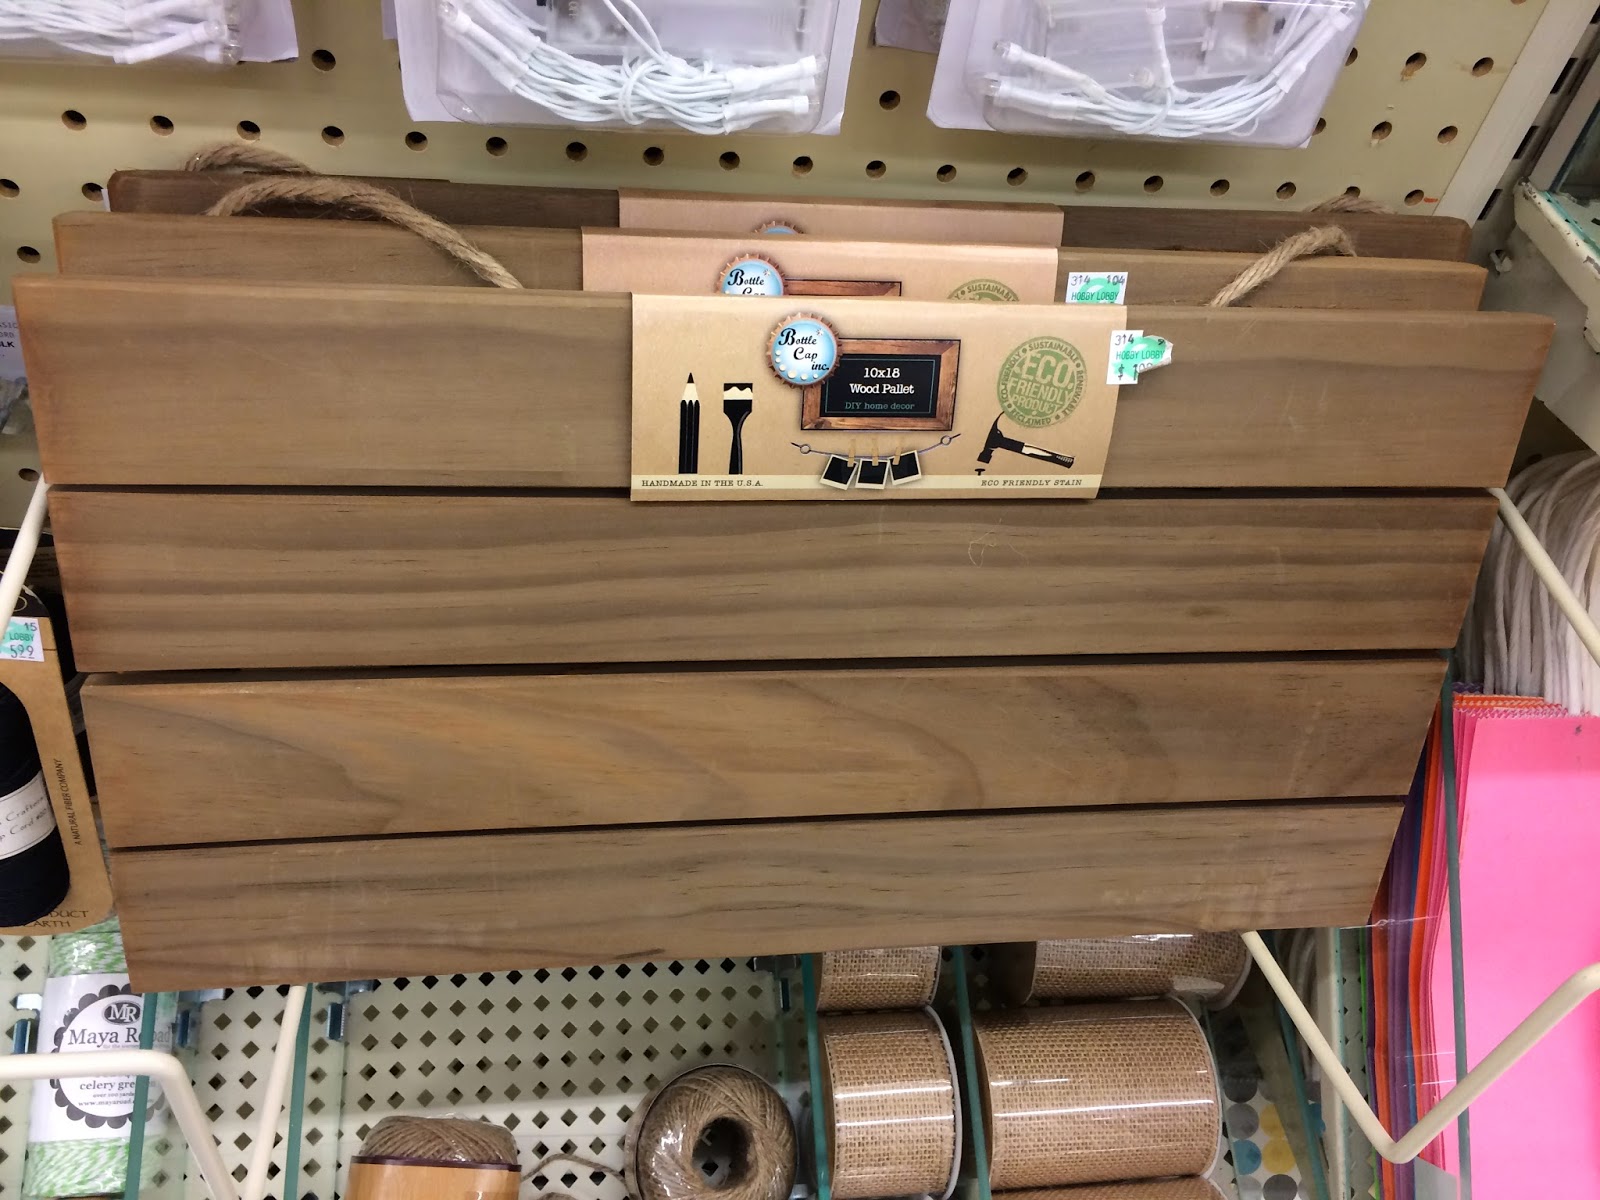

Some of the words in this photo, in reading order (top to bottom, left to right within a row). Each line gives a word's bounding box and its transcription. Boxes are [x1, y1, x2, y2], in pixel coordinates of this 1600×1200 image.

[727, 268, 765, 287] Bottle
[1071, 275, 1090, 286] 314
[1106, 275, 1125, 286] 104
[1071, 291, 1095, 301] HOBBY
[1096, 291, 1120, 301] LOBBY
[0, 321, 18, 329] SIC
[778, 327, 817, 346] Bottle
[1114, 334, 1134, 345] 314
[793, 347, 818, 363] Cap
[1028, 341, 1079, 363] SUSTAINABLE
[1116, 350, 1139, 360] HOBBY
[1141, 350, 1165, 360] LOBBY
[811, 361, 830, 371] inc.
[1021, 351, 1075, 389] ECO
[863, 367, 901, 379] 10x18
[849, 383, 880, 394] Wood
[881, 383, 915, 394] Pallet
[1007, 376, 1074, 405] FRIENDLY
[844, 402, 862, 410] DIY
[864, 401, 888, 410] home
[890, 401, 915, 410] decor
[1012, 393, 1061, 415] PRODUCT
[641, 479, 698, 487] HANDMADE
[701, 479, 711, 487] IN
[714, 479, 734, 487] THE
[737, 479, 763, 487] U.S.A.
[981, 479, 999, 487] ECO
[1002, 479, 1051, 487] FRIENDLY
[1053, 479, 1082, 487] STAIN
[9, 632, 34, 641] LOBBY
[53, 758, 69, 791] COMPANY
[61, 793, 73, 810] FIBER
[67, 812, 81, 840] NATURAL
[49, 910, 89, 918] DUCT
[24, 920, 71, 928] ARTH
[108, 1003, 137, 1022] MR
[68, 1028, 120, 1048] Maya
[80, 1080, 116, 1091] celery
